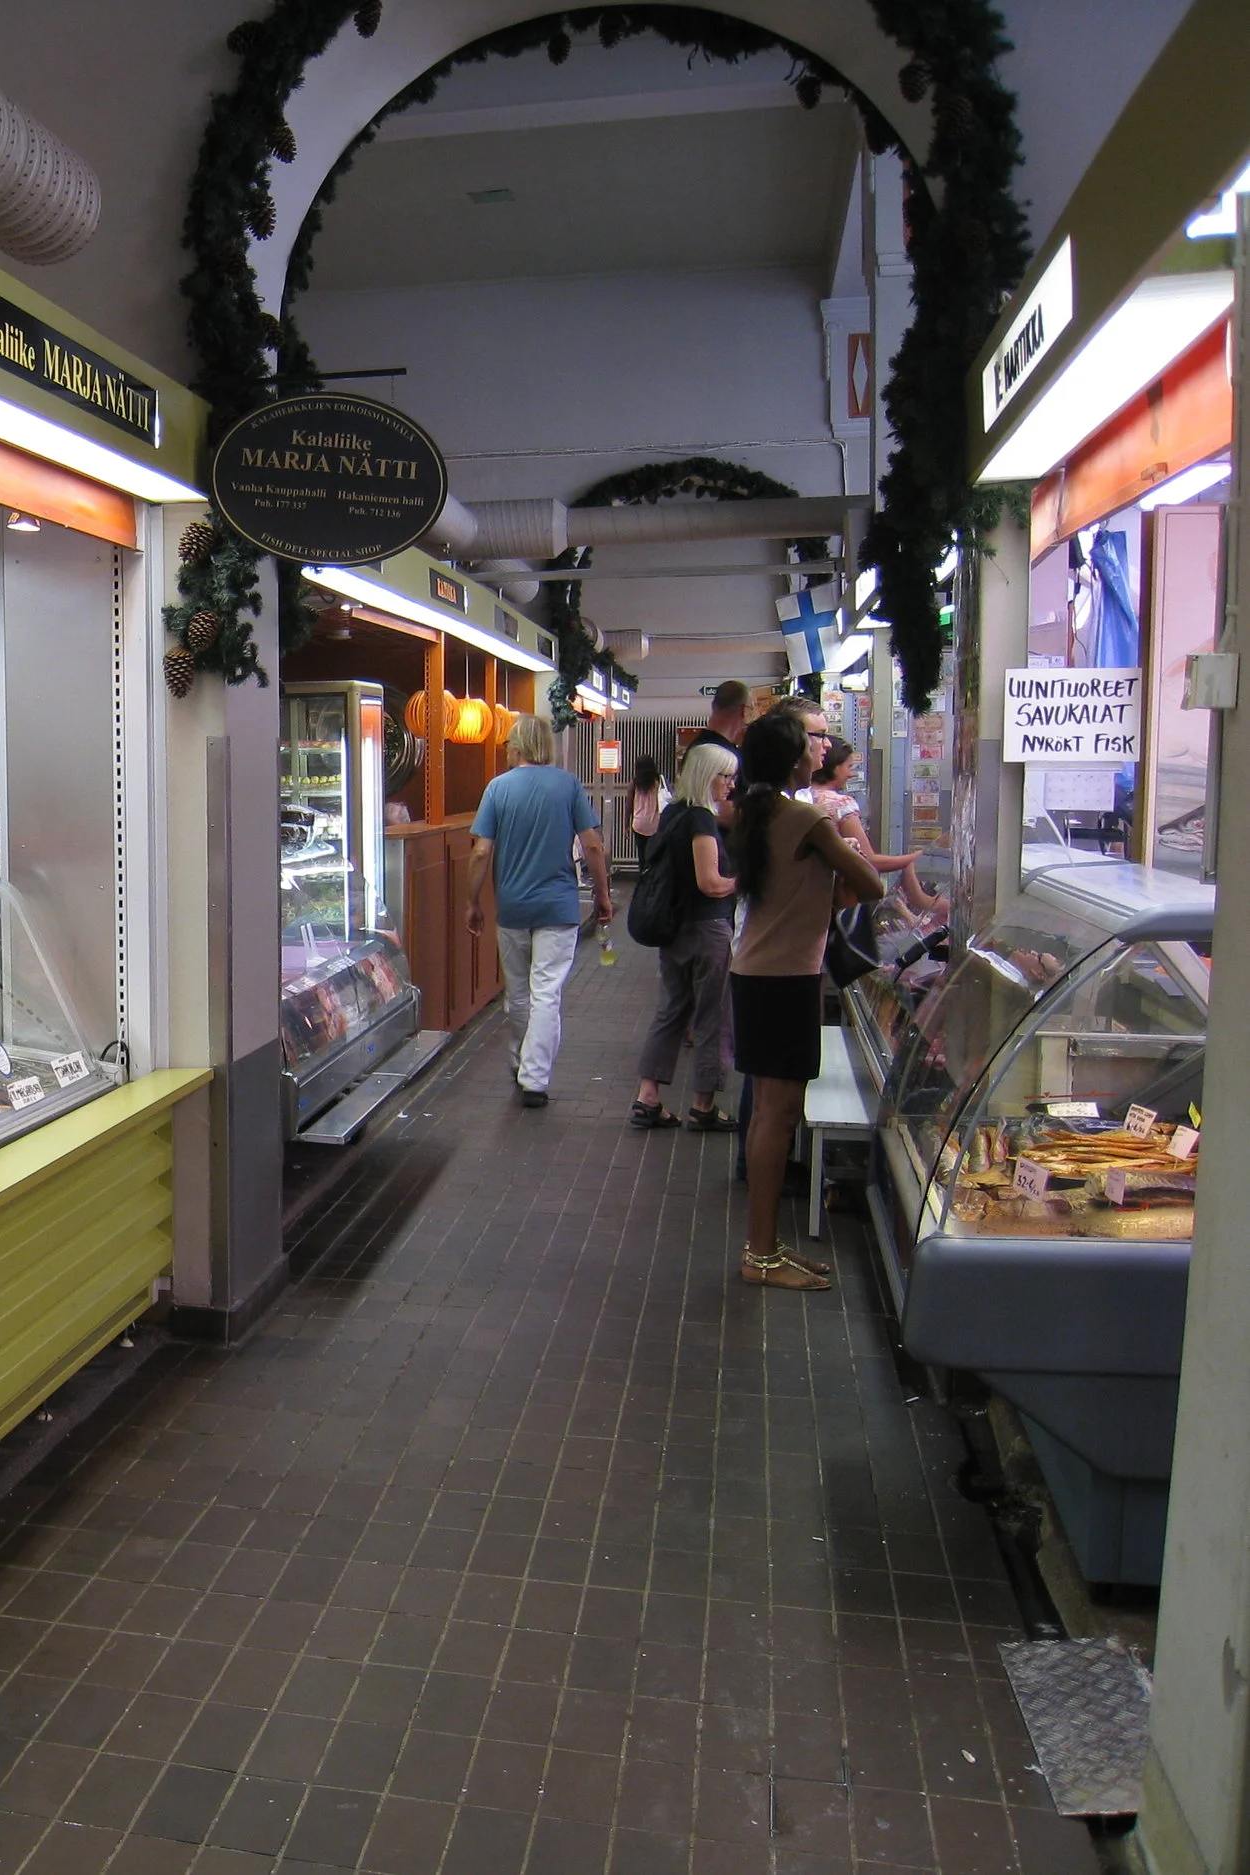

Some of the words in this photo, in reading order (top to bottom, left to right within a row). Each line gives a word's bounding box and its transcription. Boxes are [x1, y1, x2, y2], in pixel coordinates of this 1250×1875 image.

[43, 338, 103, 407] MARJA
[105, 372, 150, 433] NÄTTI
[291, 429, 372, 450] Kalaliike
[240, 447, 331, 474] MARJA
[338, 452, 419, 480] NÄTTI
[231, 481, 263, 494] Vanha
[266, 484, 327, 499] Kauppahalli
[337, 490, 400, 505] Hakaniemen
[402, 492, 425, 507] halli
[254, 498, 274, 509] Puh.
[349, 506, 369, 517] Puh.
[260, 532, 284, 549] FISH
[309, 549, 353, 559] SPECIAL
[355, 544, 382, 556] SHOP
[1008, 677, 1139, 700] UUNITUOREET
[1014, 703, 1134, 727] SAVUKALAT
[1094, 733, 1135, 755] FISK
